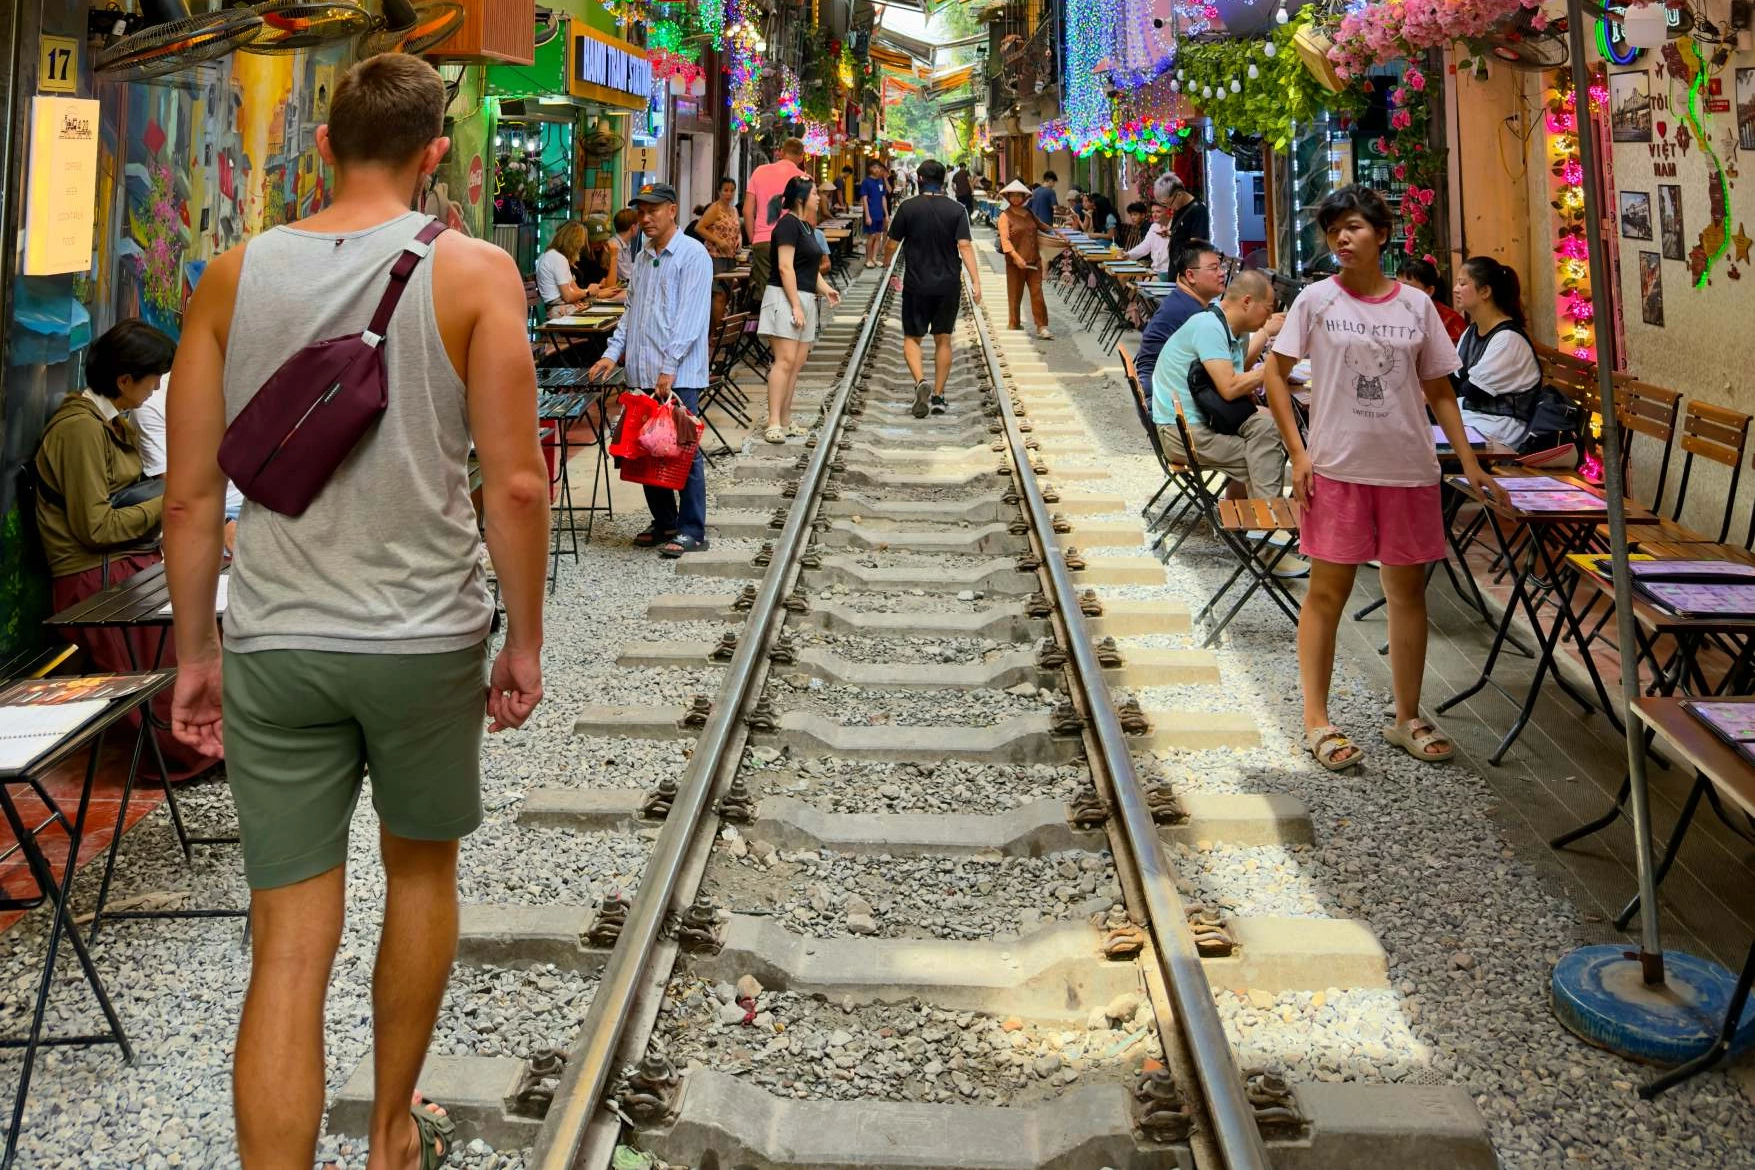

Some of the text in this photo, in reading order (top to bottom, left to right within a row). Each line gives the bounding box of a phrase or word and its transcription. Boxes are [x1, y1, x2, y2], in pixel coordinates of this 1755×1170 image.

[48, 47, 72, 80] 17
[584, 35, 607, 86] HANOI
[607, 44, 628, 92] TRAIN
[1650, 92, 1668, 111] TÔI
[1648, 139, 1677, 161] VIỆT
[1653, 162, 1677, 178] NAM
[1326, 319, 1416, 340] HELLO KITTY
